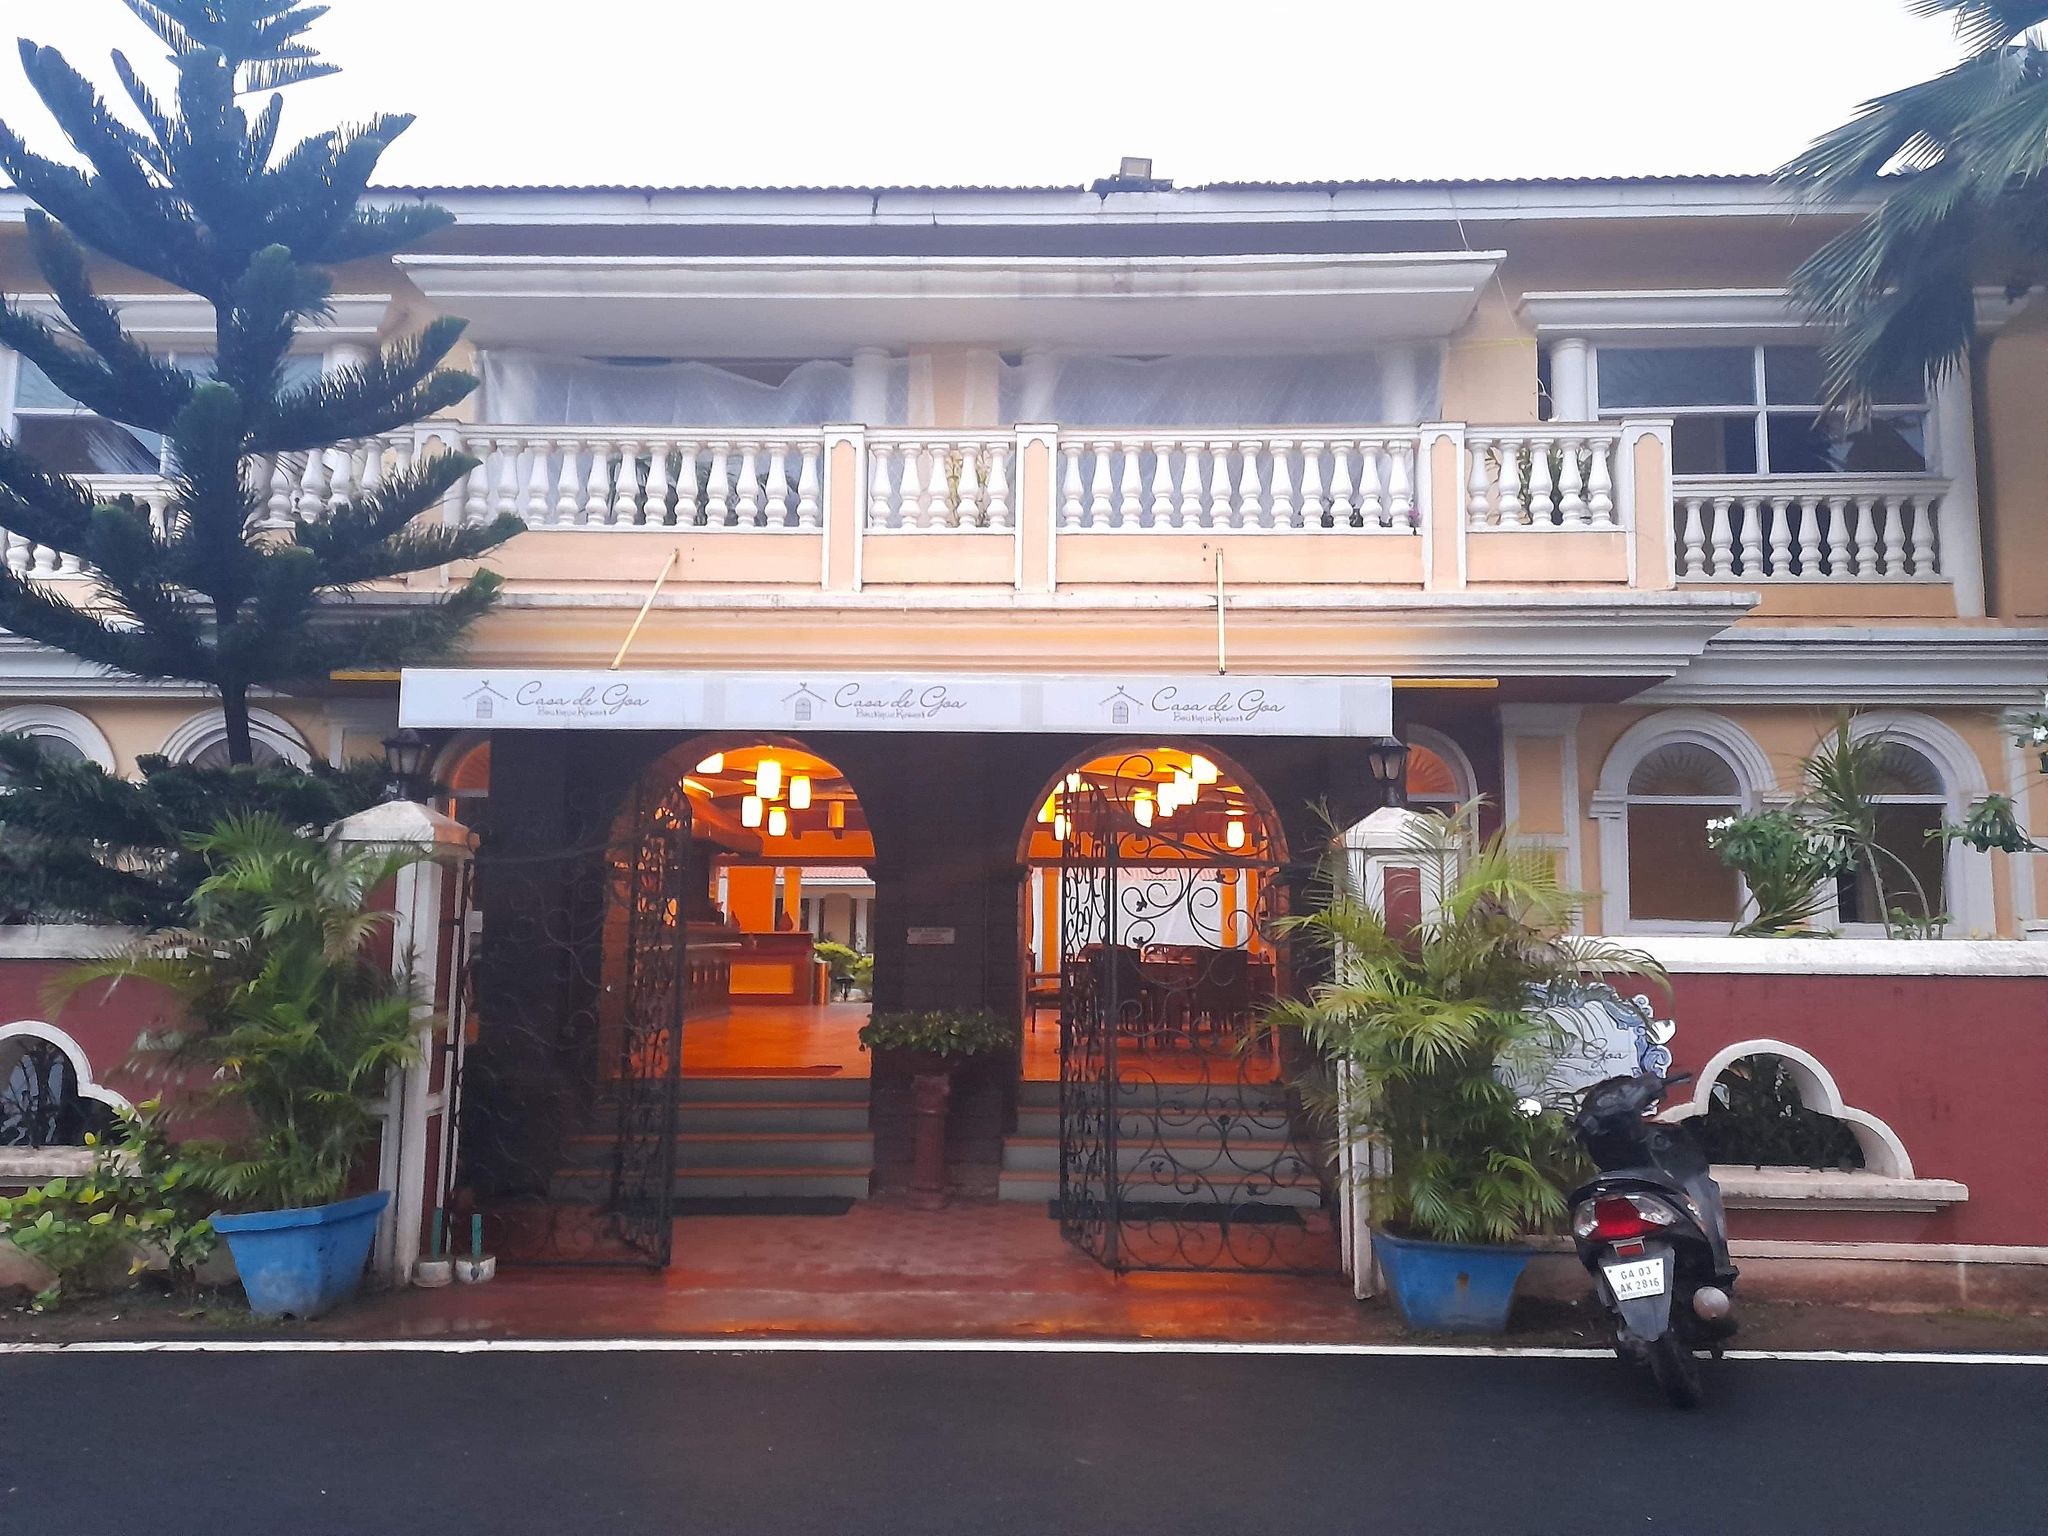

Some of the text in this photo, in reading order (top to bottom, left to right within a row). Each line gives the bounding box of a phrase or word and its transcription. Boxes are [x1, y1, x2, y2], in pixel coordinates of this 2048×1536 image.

[516, 680, 650, 715] Casa de Goa
[834, 682, 967, 717] Casa de Goa
[1151, 686, 1285, 721] Casa de Goa
[1582, 1038, 1629, 1068] Goa
[1620, 1277, 1660, 1293] AK 2816
[1621, 1266, 1652, 1280] GA 03
